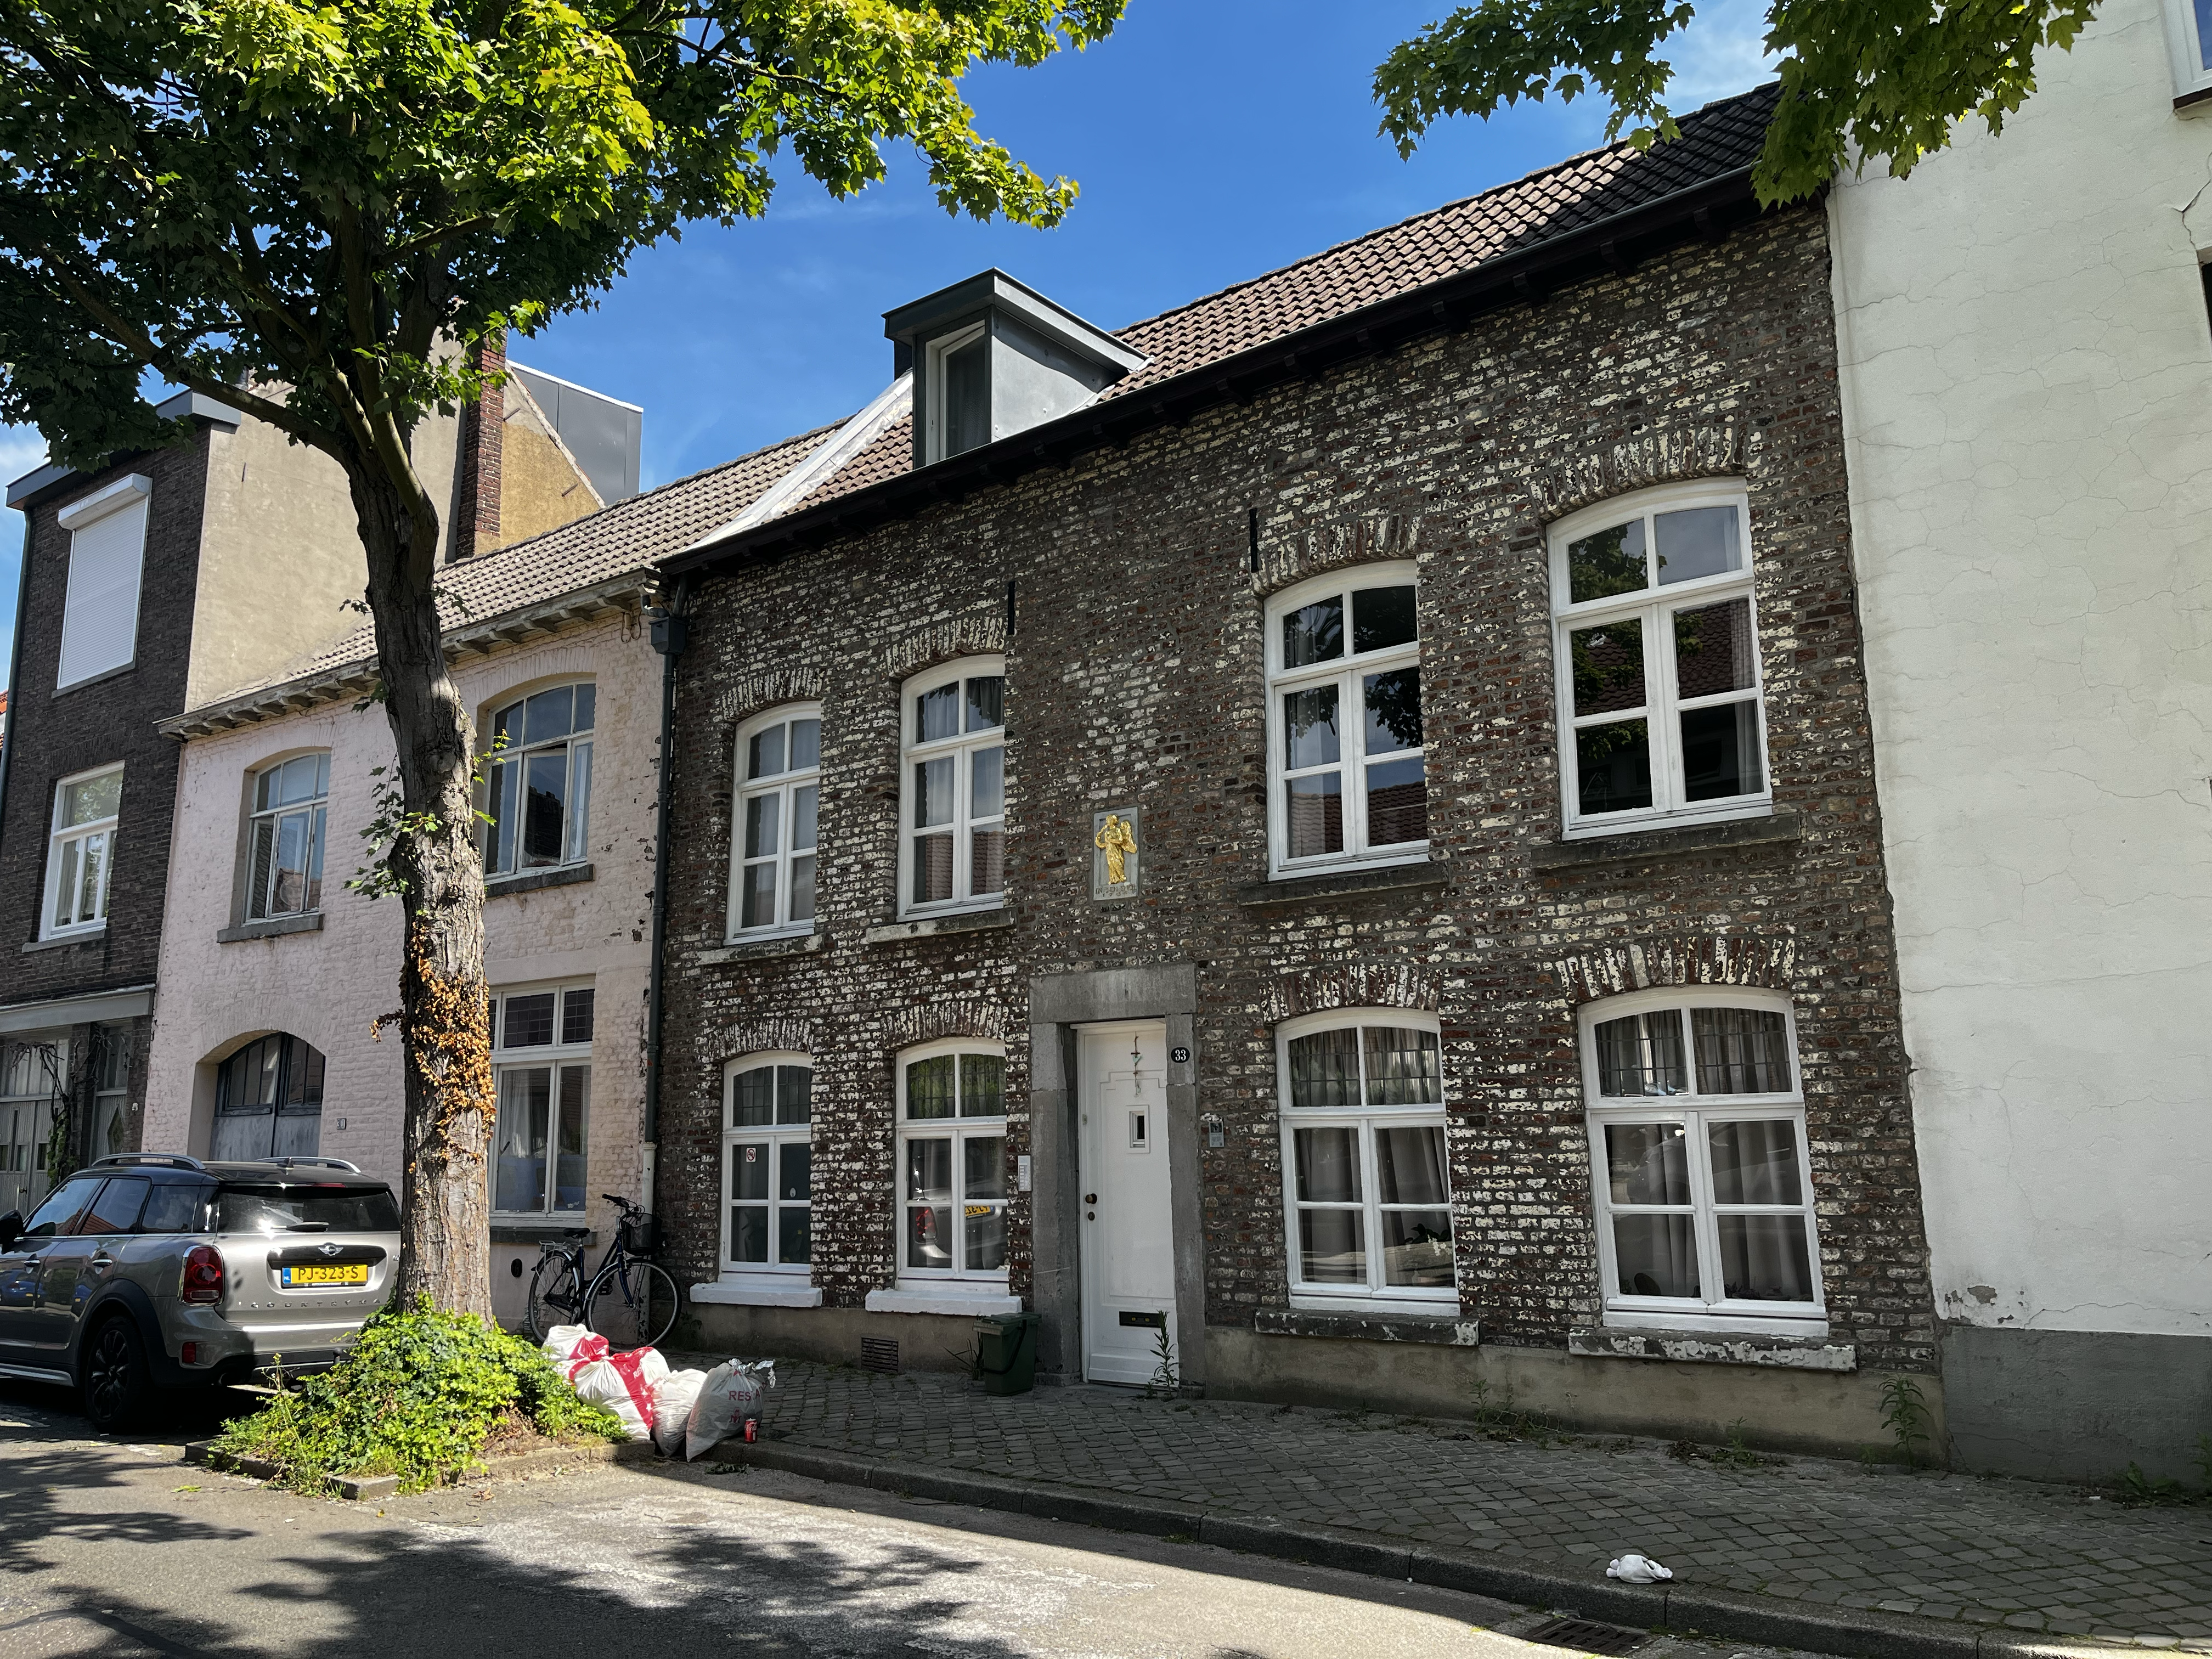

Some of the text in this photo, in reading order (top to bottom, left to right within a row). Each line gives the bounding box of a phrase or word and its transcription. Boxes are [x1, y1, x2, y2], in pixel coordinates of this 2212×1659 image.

[1175, 1049, 1186, 1061] 33
[298, 1266, 359, 1280] PJ-323-S
[251, 1298, 381, 1308] COUNTRYMA
